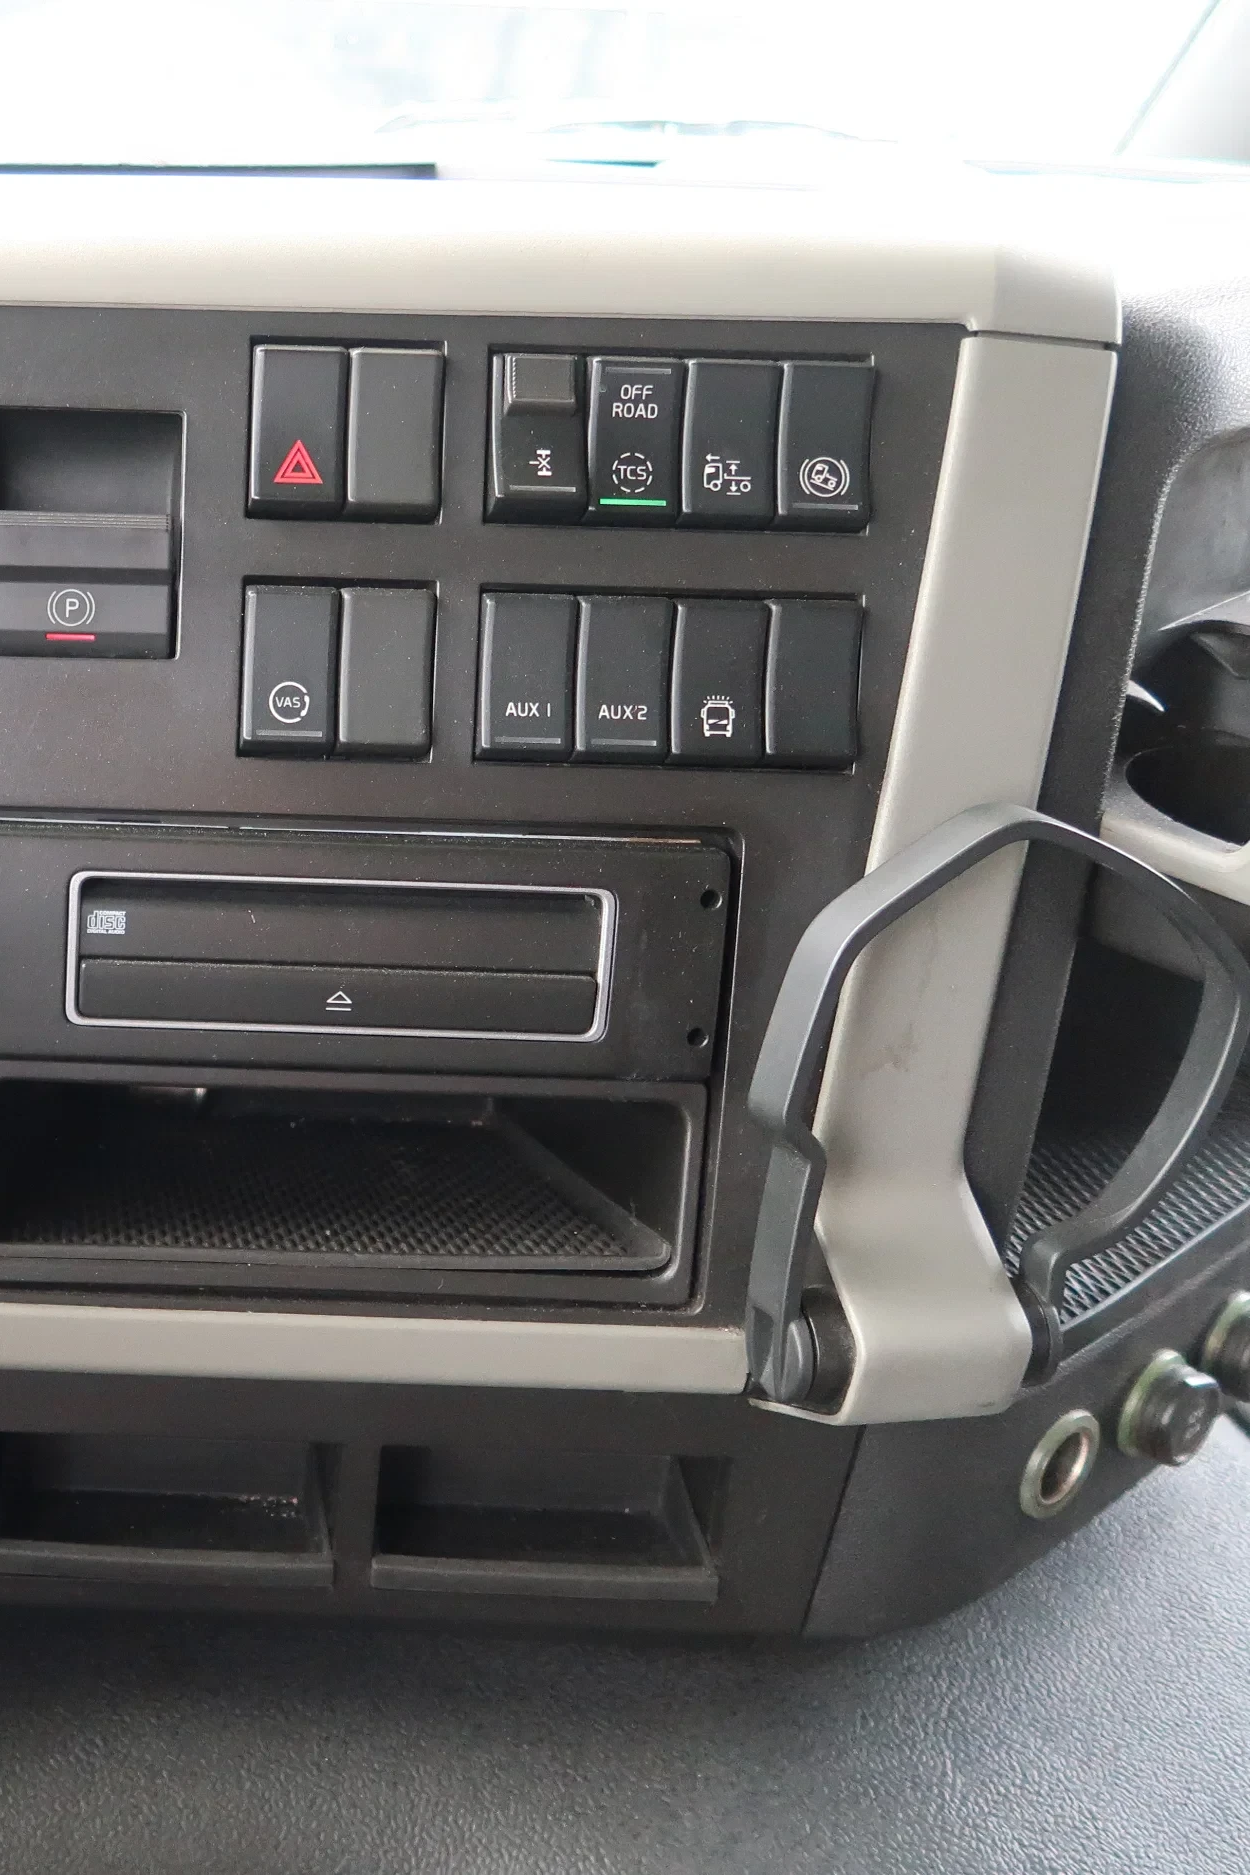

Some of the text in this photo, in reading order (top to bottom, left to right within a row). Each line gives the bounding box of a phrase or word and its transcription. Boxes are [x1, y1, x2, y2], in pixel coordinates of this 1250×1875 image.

[619, 383, 655, 401] OFF
[612, 402, 658, 419] ROAD
[616, 465, 648, 481] TCS
[274, 695, 302, 709] VAS
